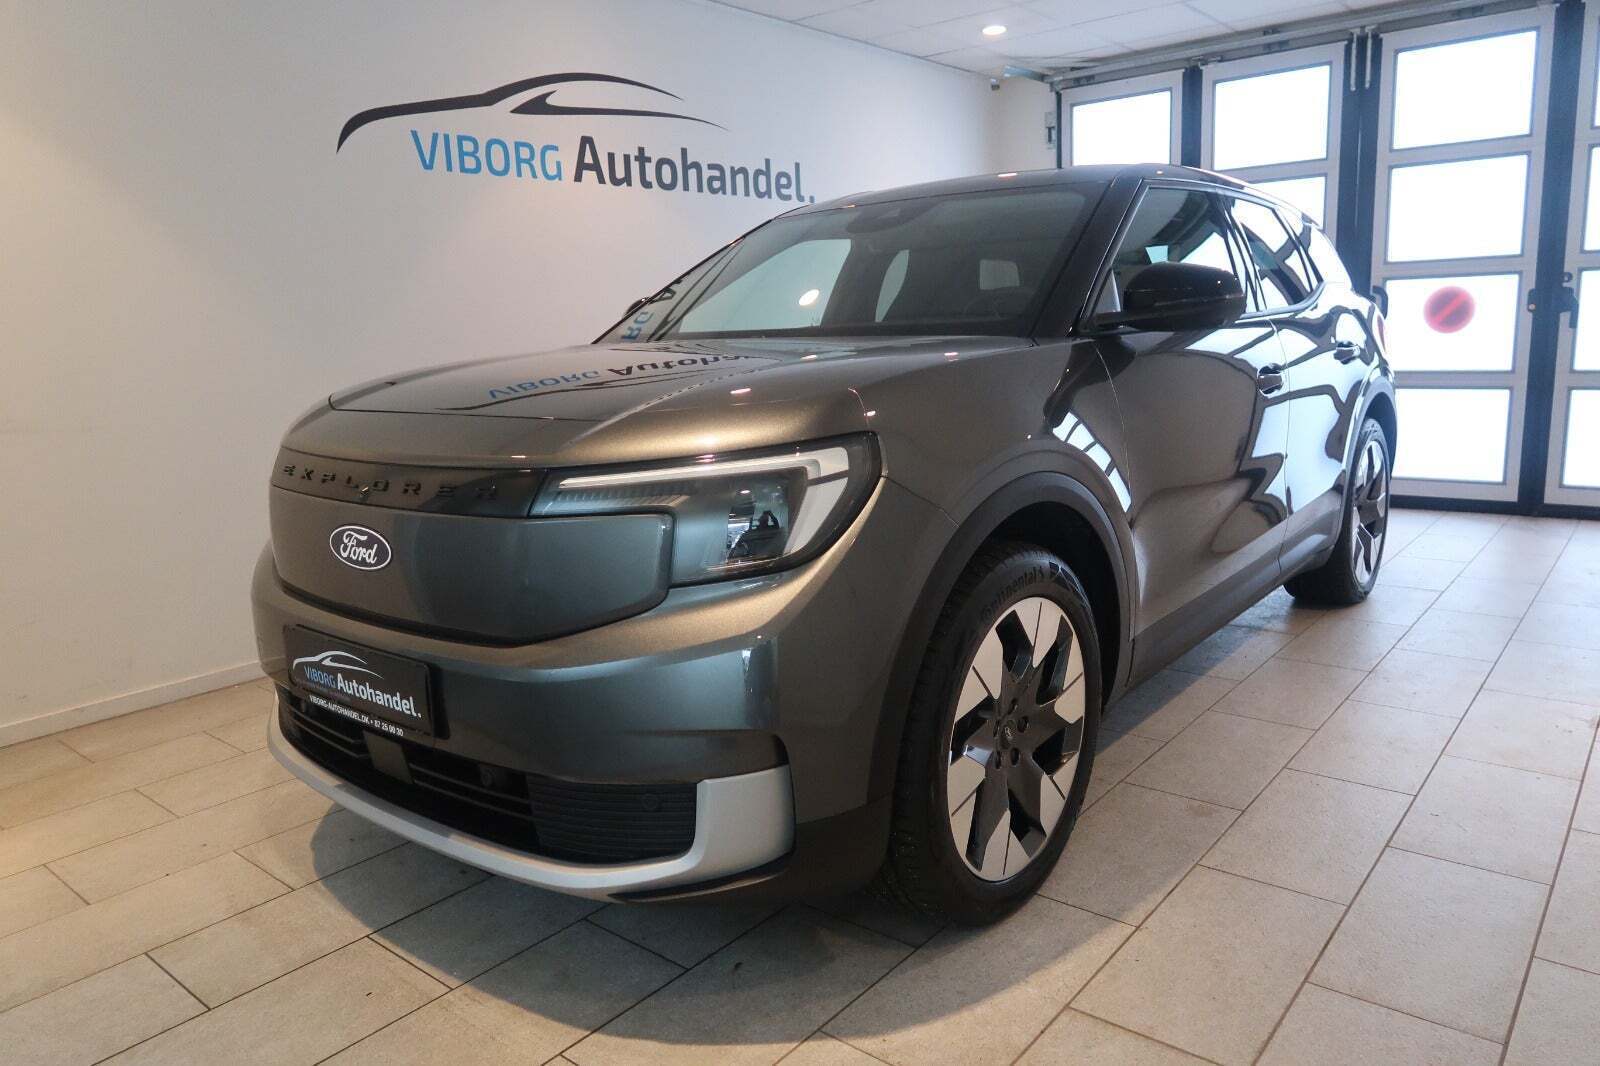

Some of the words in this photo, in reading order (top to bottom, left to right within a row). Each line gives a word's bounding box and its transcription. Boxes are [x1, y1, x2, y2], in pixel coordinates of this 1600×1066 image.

[410, 129, 563, 181] VIBORG
[573, 135, 816, 204] Autohandel.
[283, 464, 497, 500] EXPLORER
[340, 530, 378, 565] Ford
[304, 665, 337, 689] VIBORG
[337, 672, 422, 720] Autohandel.
